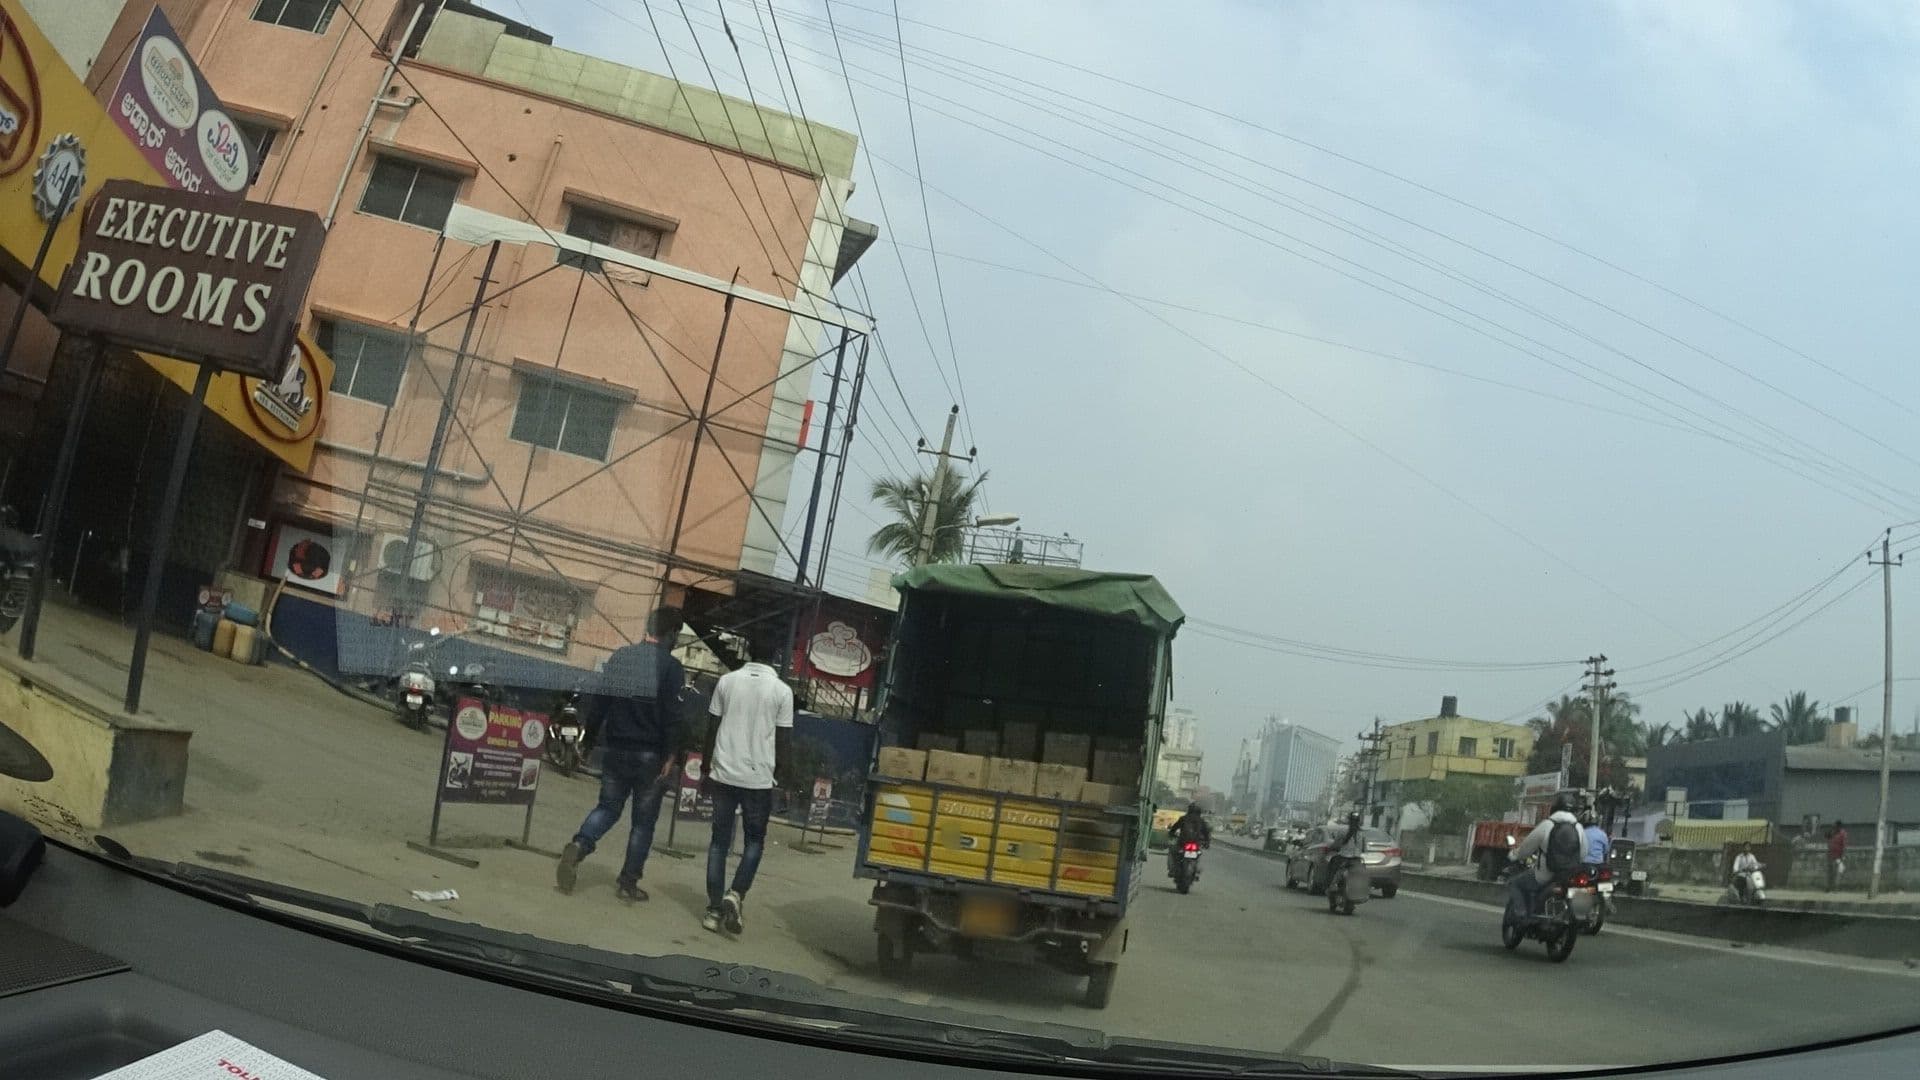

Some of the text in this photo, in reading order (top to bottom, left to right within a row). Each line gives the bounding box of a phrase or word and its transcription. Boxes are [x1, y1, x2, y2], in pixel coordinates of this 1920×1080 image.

[96, 197, 296, 269] EXECUTIVE
[72, 251, 272, 332] ROOMS
[488, 710, 522, 728] PARKING
[217, 1059, 262, 1080] TOL
